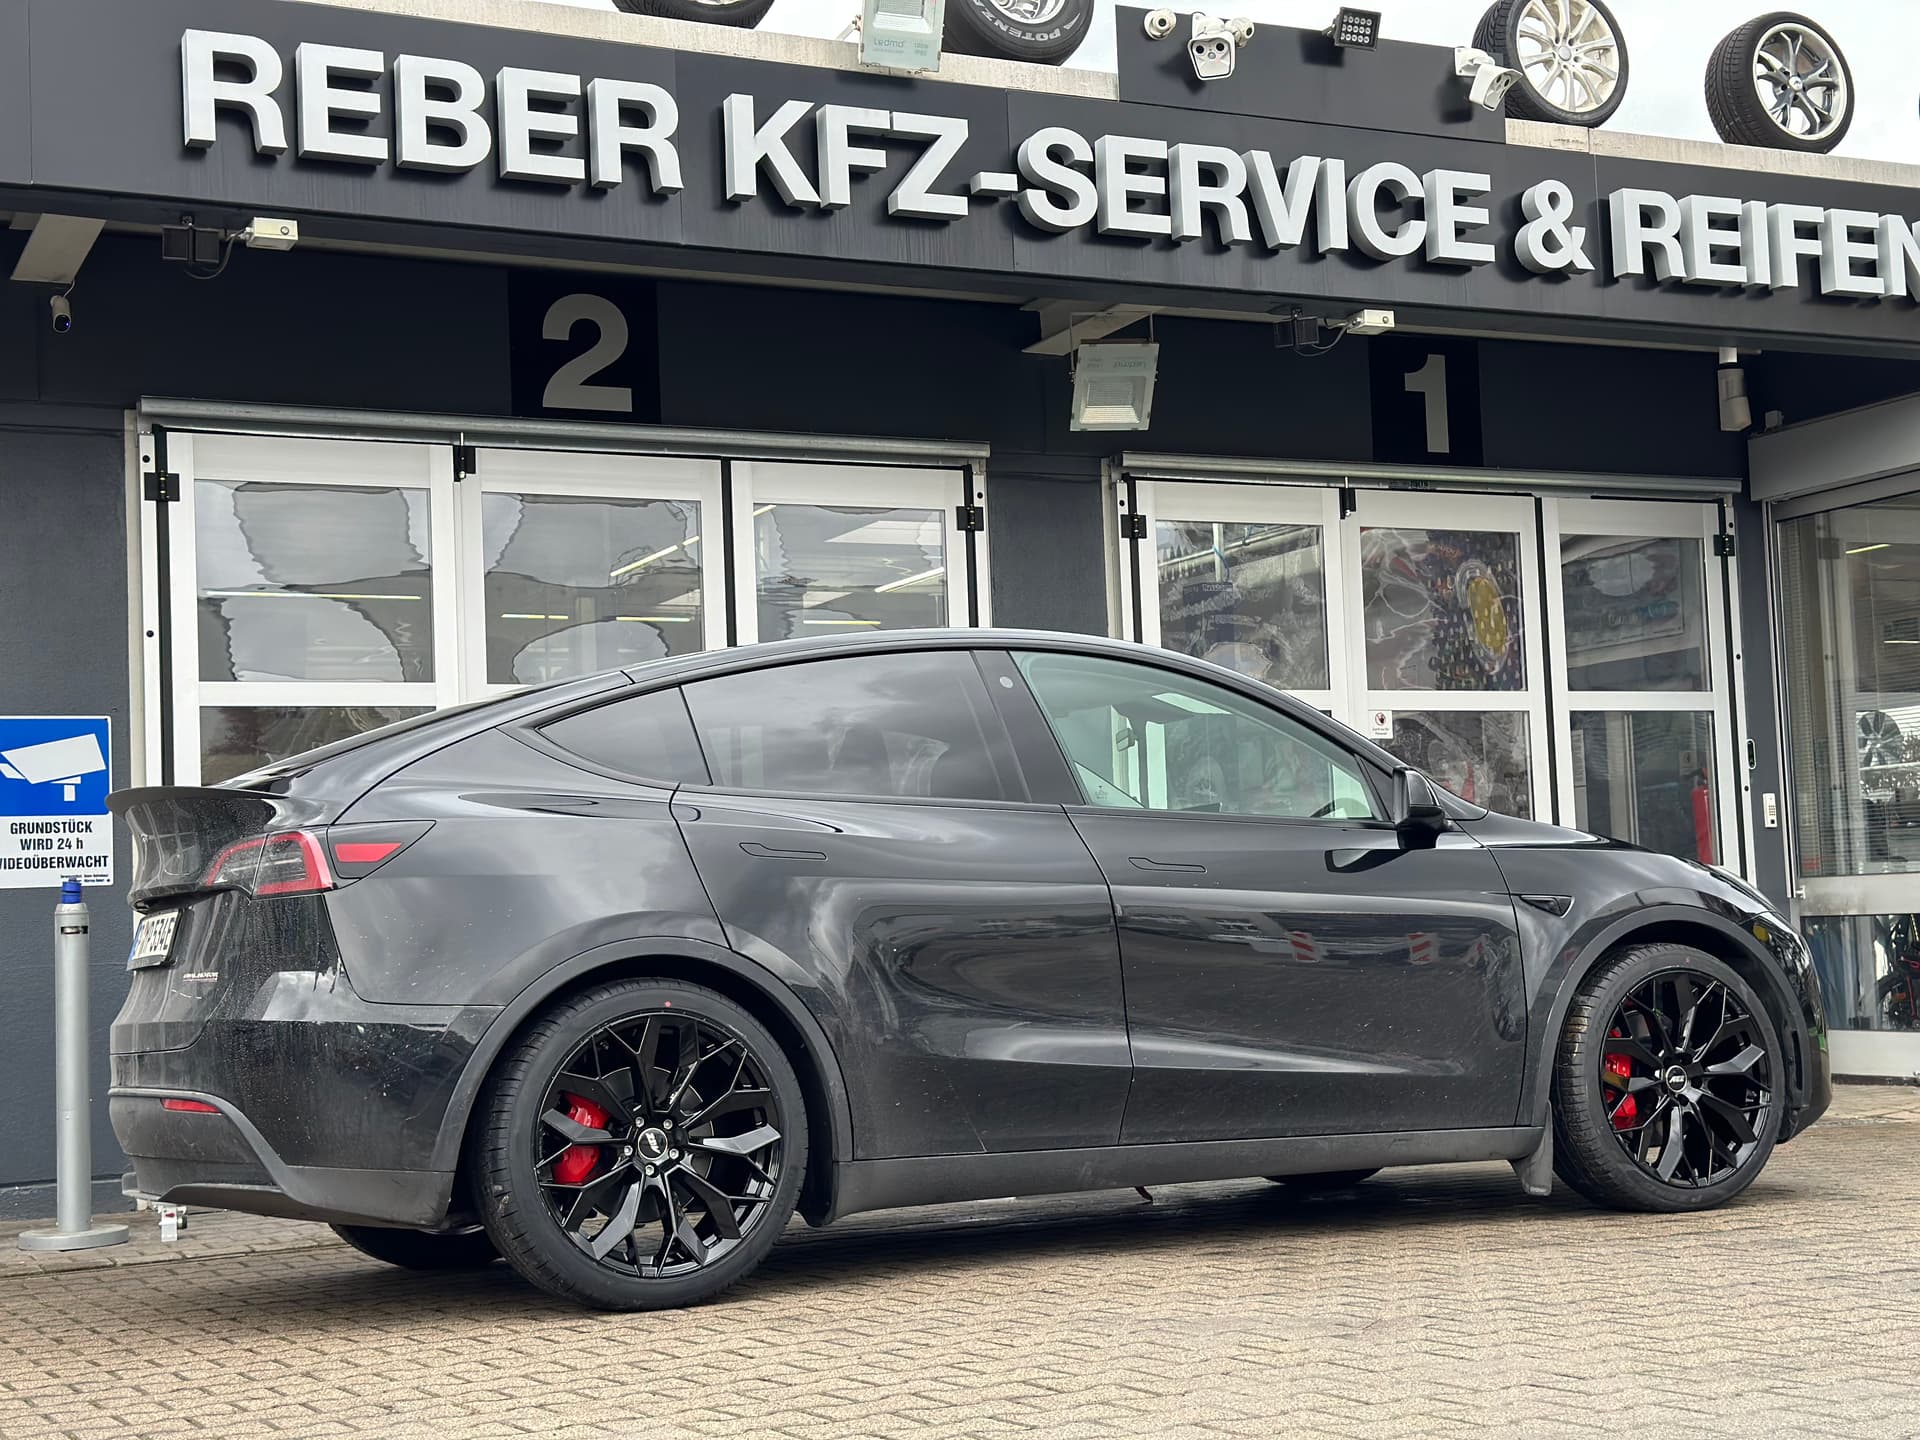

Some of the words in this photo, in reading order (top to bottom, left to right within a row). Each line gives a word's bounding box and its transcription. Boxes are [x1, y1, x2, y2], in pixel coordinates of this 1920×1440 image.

[181, 28, 685, 195] REBER
[723, 93, 1496, 267] KFZ-SERVICE
[1514, 179, 1595, 275] &
[1608, 187, 1920, 304] REIFEN
[541, 293, 633, 412] 2
[1403, 353, 1450, 453] 1
[10, 819, 93, 834] GRUNDSTÜCK
[20, 838, 53, 850] WIRD
[57, 838, 72, 850] 24
[76, 838, 83, 849] h
